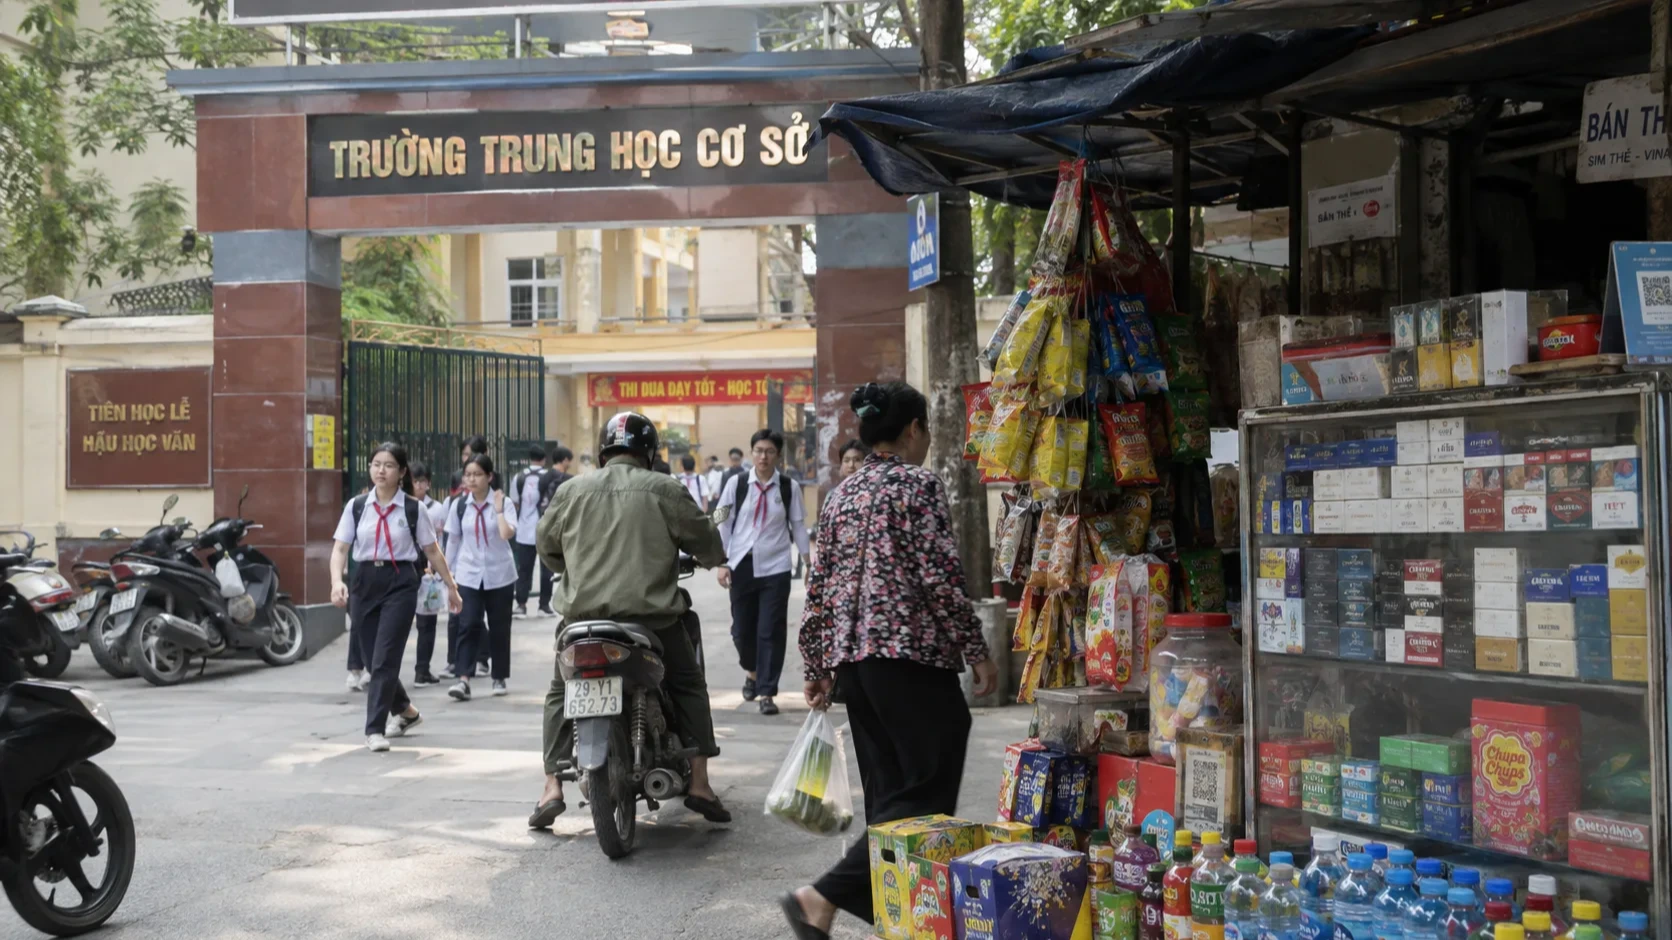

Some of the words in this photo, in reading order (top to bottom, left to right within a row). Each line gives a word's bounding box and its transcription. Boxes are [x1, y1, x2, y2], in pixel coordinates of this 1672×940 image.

[1587, 102, 1629, 143] BÁN
[329, 127, 467, 179] TRƯỜNG
[480, 131, 596, 175] TRUNG
[610, 128, 681, 179] HỌC
[696, 123, 746, 167] CƠ
[759, 111, 810, 166] SỞ
[1588, 153, 1606, 167] SIM
[619, 381, 638, 398] THI
[694, 375, 716, 397] TỐT
[727, 379, 752, 400] HỌC
[88, 400, 126, 422] TIÊN
[131, 403, 165, 425] HỌC
[170, 396, 191, 421] LỄ
[122, 434, 157, 456] HỌC
[569, 696, 617, 715] 652.73
[1486, 745, 1526, 766] Chupa
[1485, 759, 1525, 780] Chups
